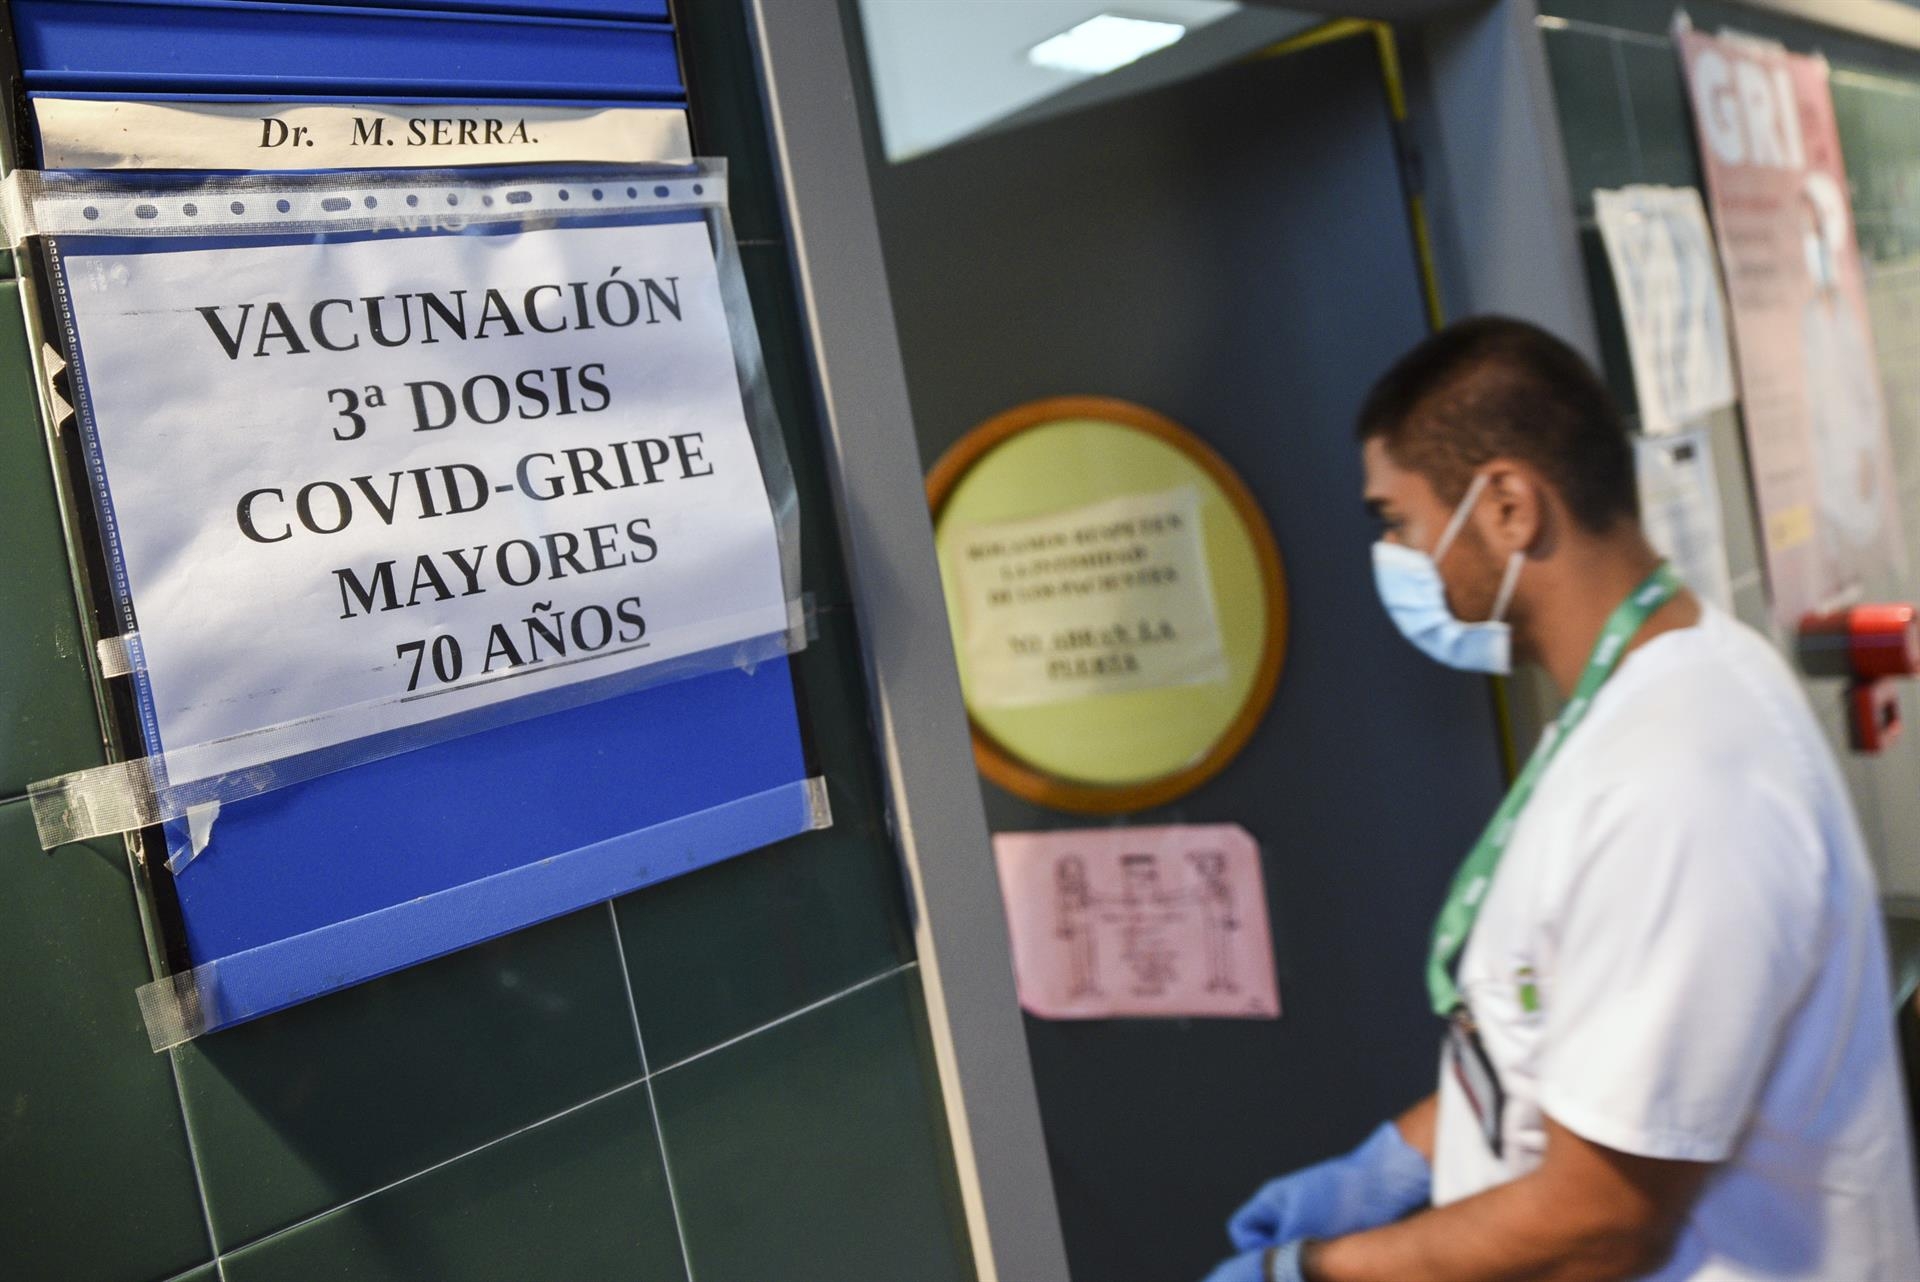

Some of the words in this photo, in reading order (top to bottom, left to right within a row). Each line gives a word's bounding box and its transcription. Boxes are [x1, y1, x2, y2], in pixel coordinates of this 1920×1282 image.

[260, 118, 315, 148] Dr.
[351, 117, 394, 146] M.
[406, 118, 541, 146] SERRA.
[195, 267, 682, 360] VACUNACIÓN
[328, 385, 387, 441] 3ª
[404, 363, 611, 432] DOSIS
[236, 432, 714, 544] COVID-GRIPE
[332, 518, 658, 620] MAYORES
[396, 634, 463, 692] 70
[481, 597, 646, 674] AÑOS
